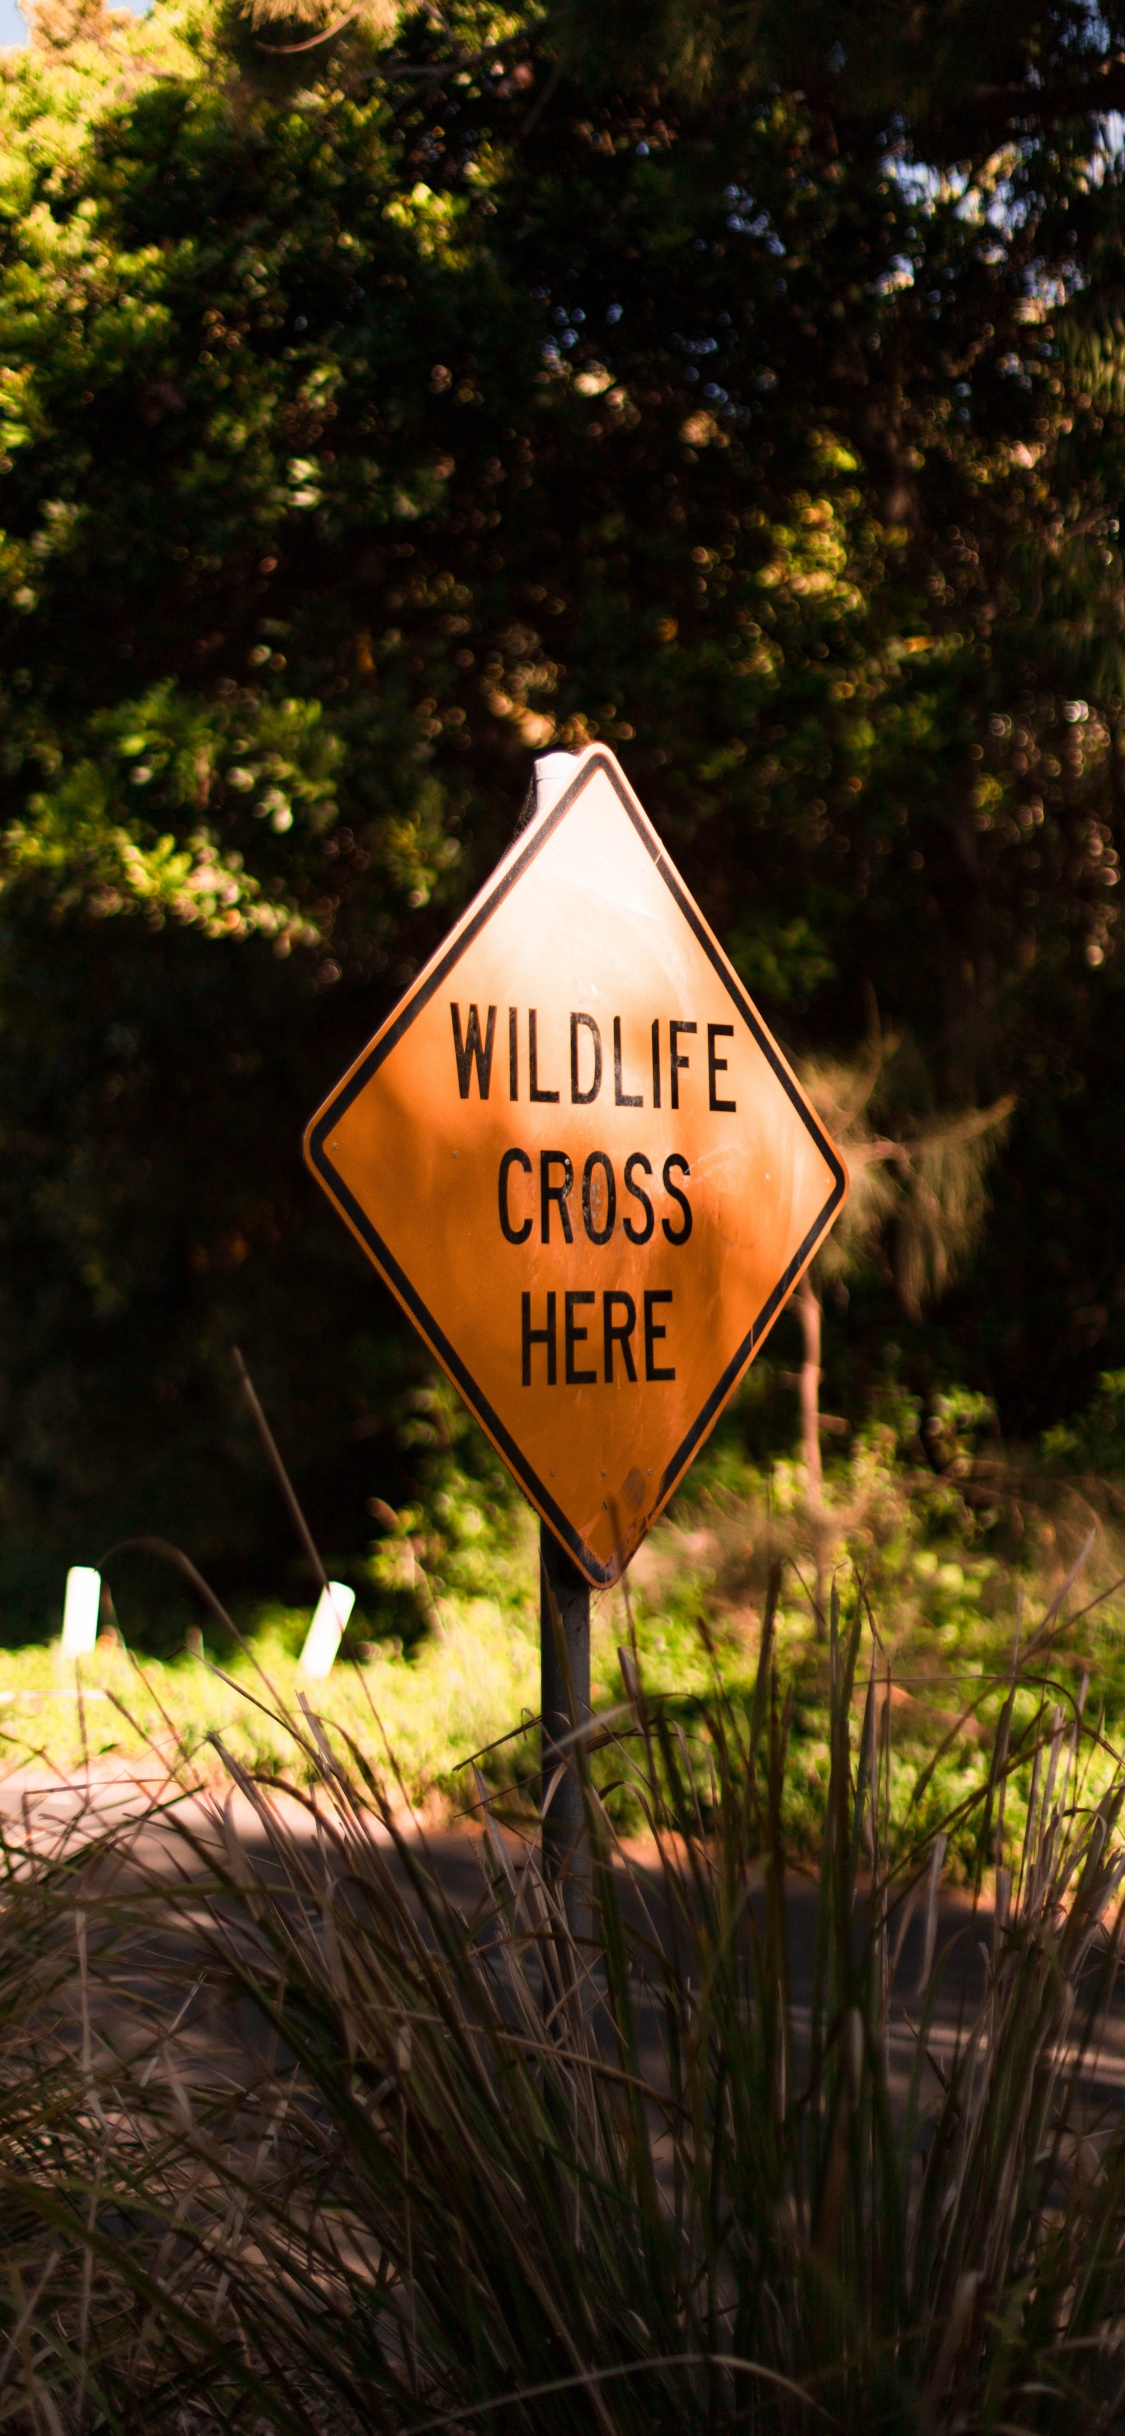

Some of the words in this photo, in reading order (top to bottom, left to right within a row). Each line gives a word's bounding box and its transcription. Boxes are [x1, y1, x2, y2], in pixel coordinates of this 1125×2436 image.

[450, 1002, 737, 1113] WILDLIFE
[497, 1147, 693, 1246] CROSS
[521, 1289, 676, 1388] HERE
